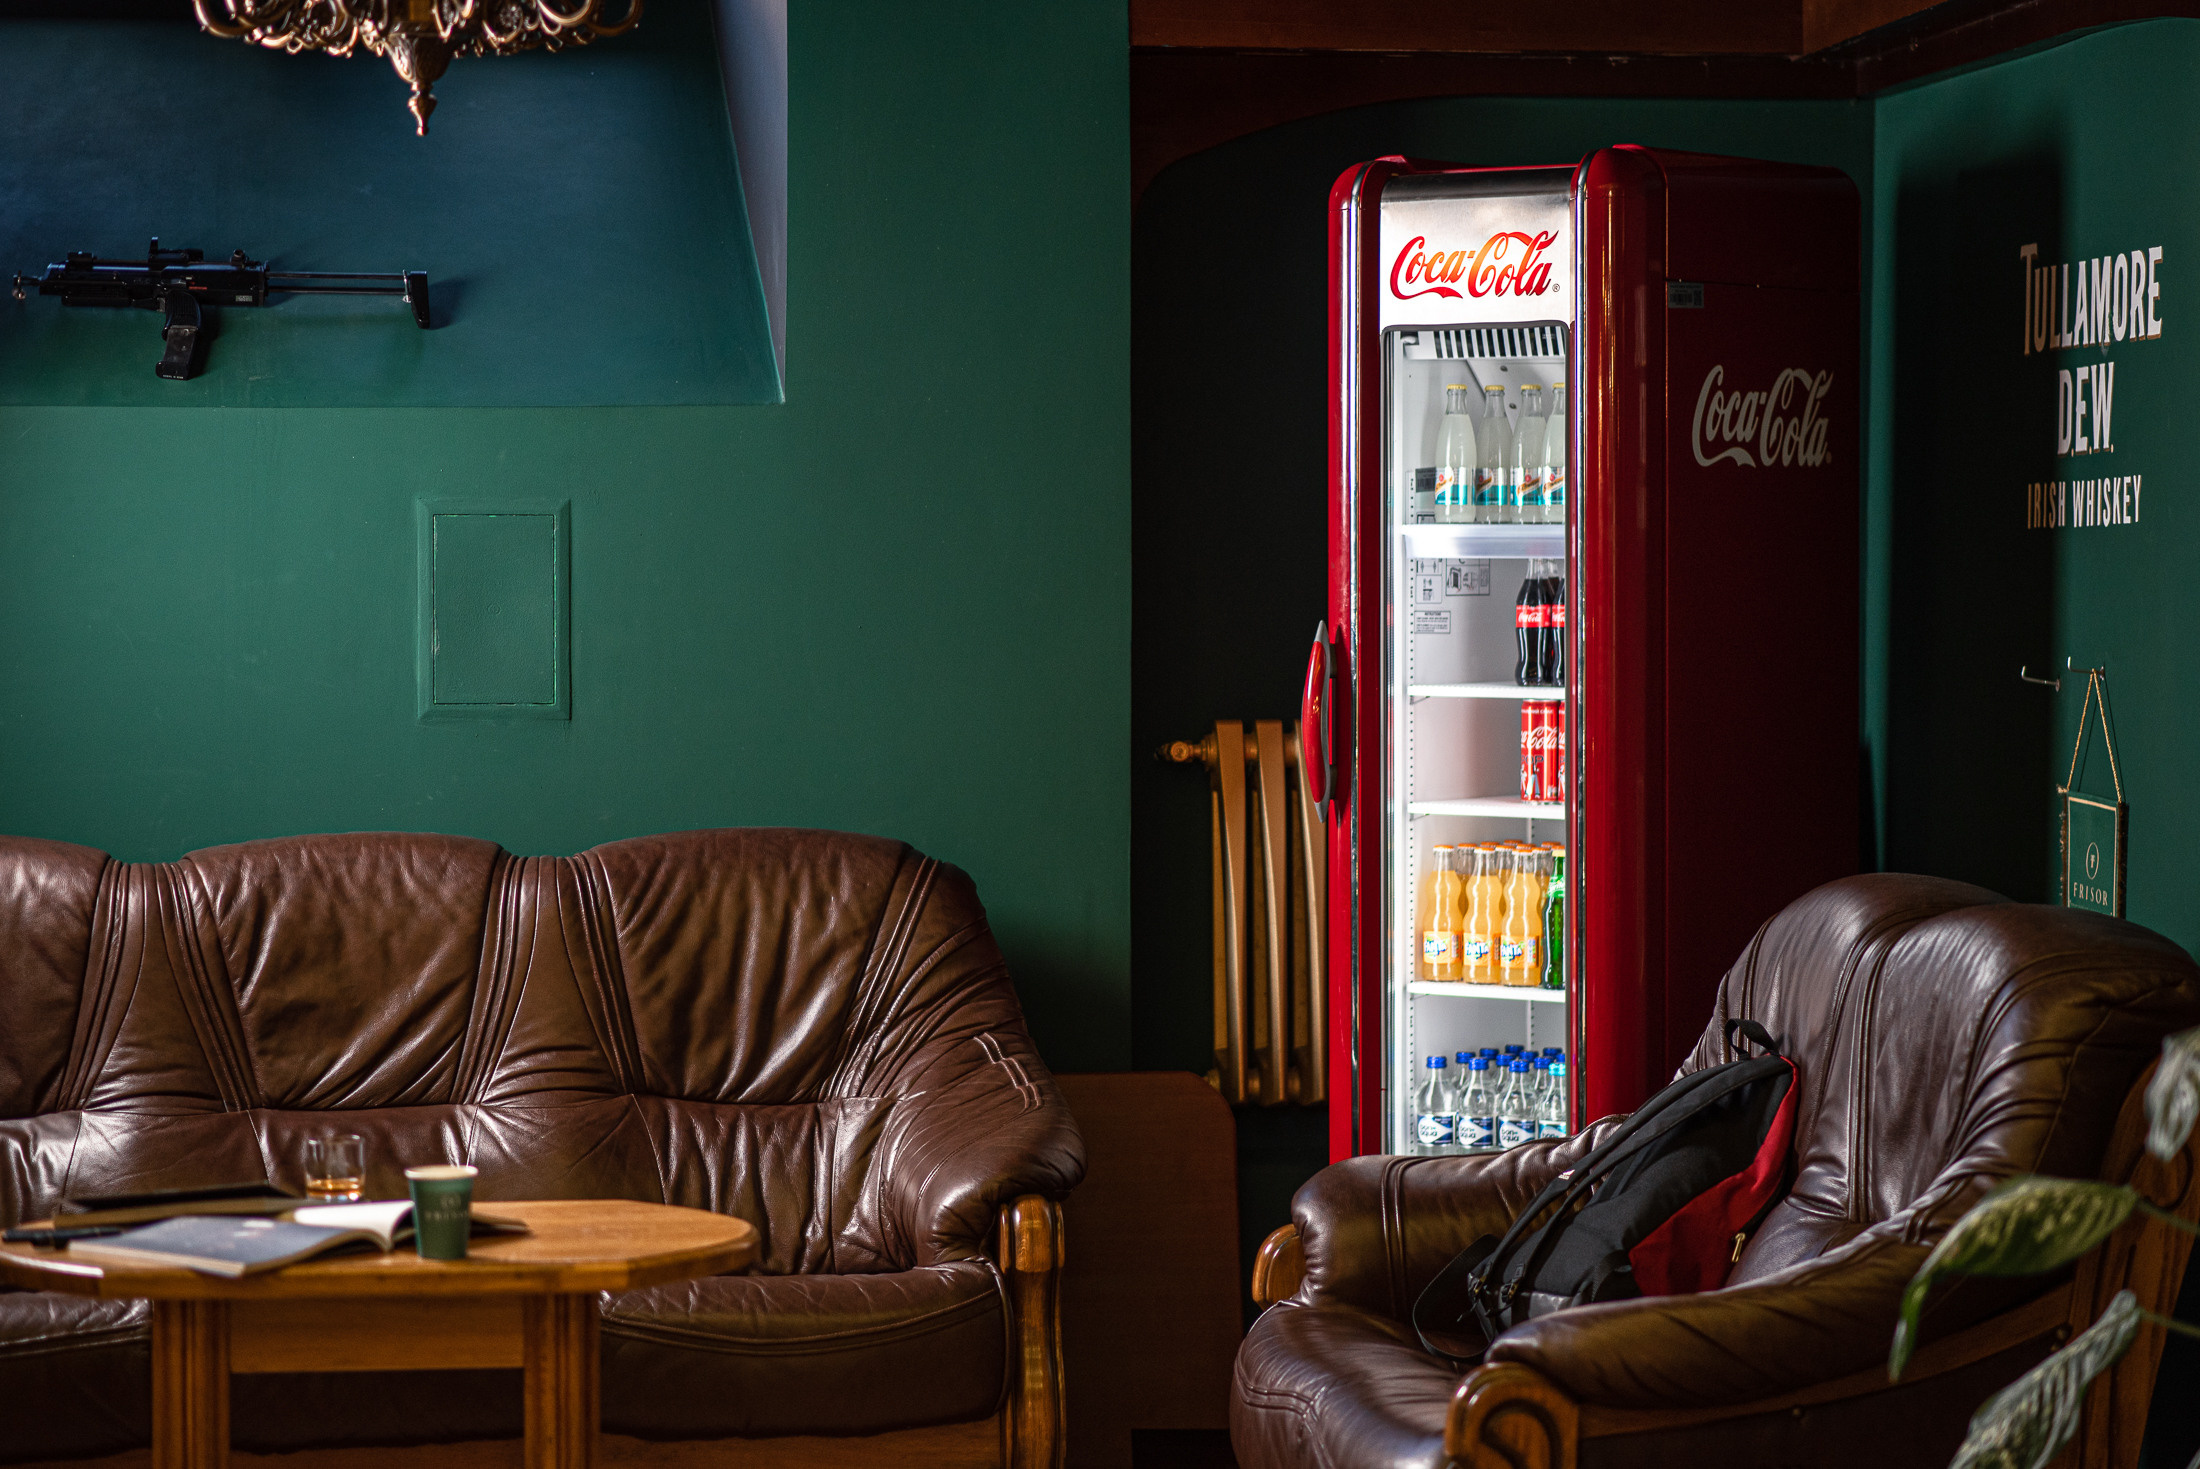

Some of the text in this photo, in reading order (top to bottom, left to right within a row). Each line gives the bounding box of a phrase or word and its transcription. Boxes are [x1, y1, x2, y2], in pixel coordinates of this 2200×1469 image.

[1390, 230, 1559, 300] Coca-Cola
[2020, 243, 2163, 356] TULLAMORE
[1692, 364, 1834, 469] Coca-Cola
[2027, 474, 2142, 529] IRISH WHISKEY
[2073, 882, 2108, 906] FRISOR
